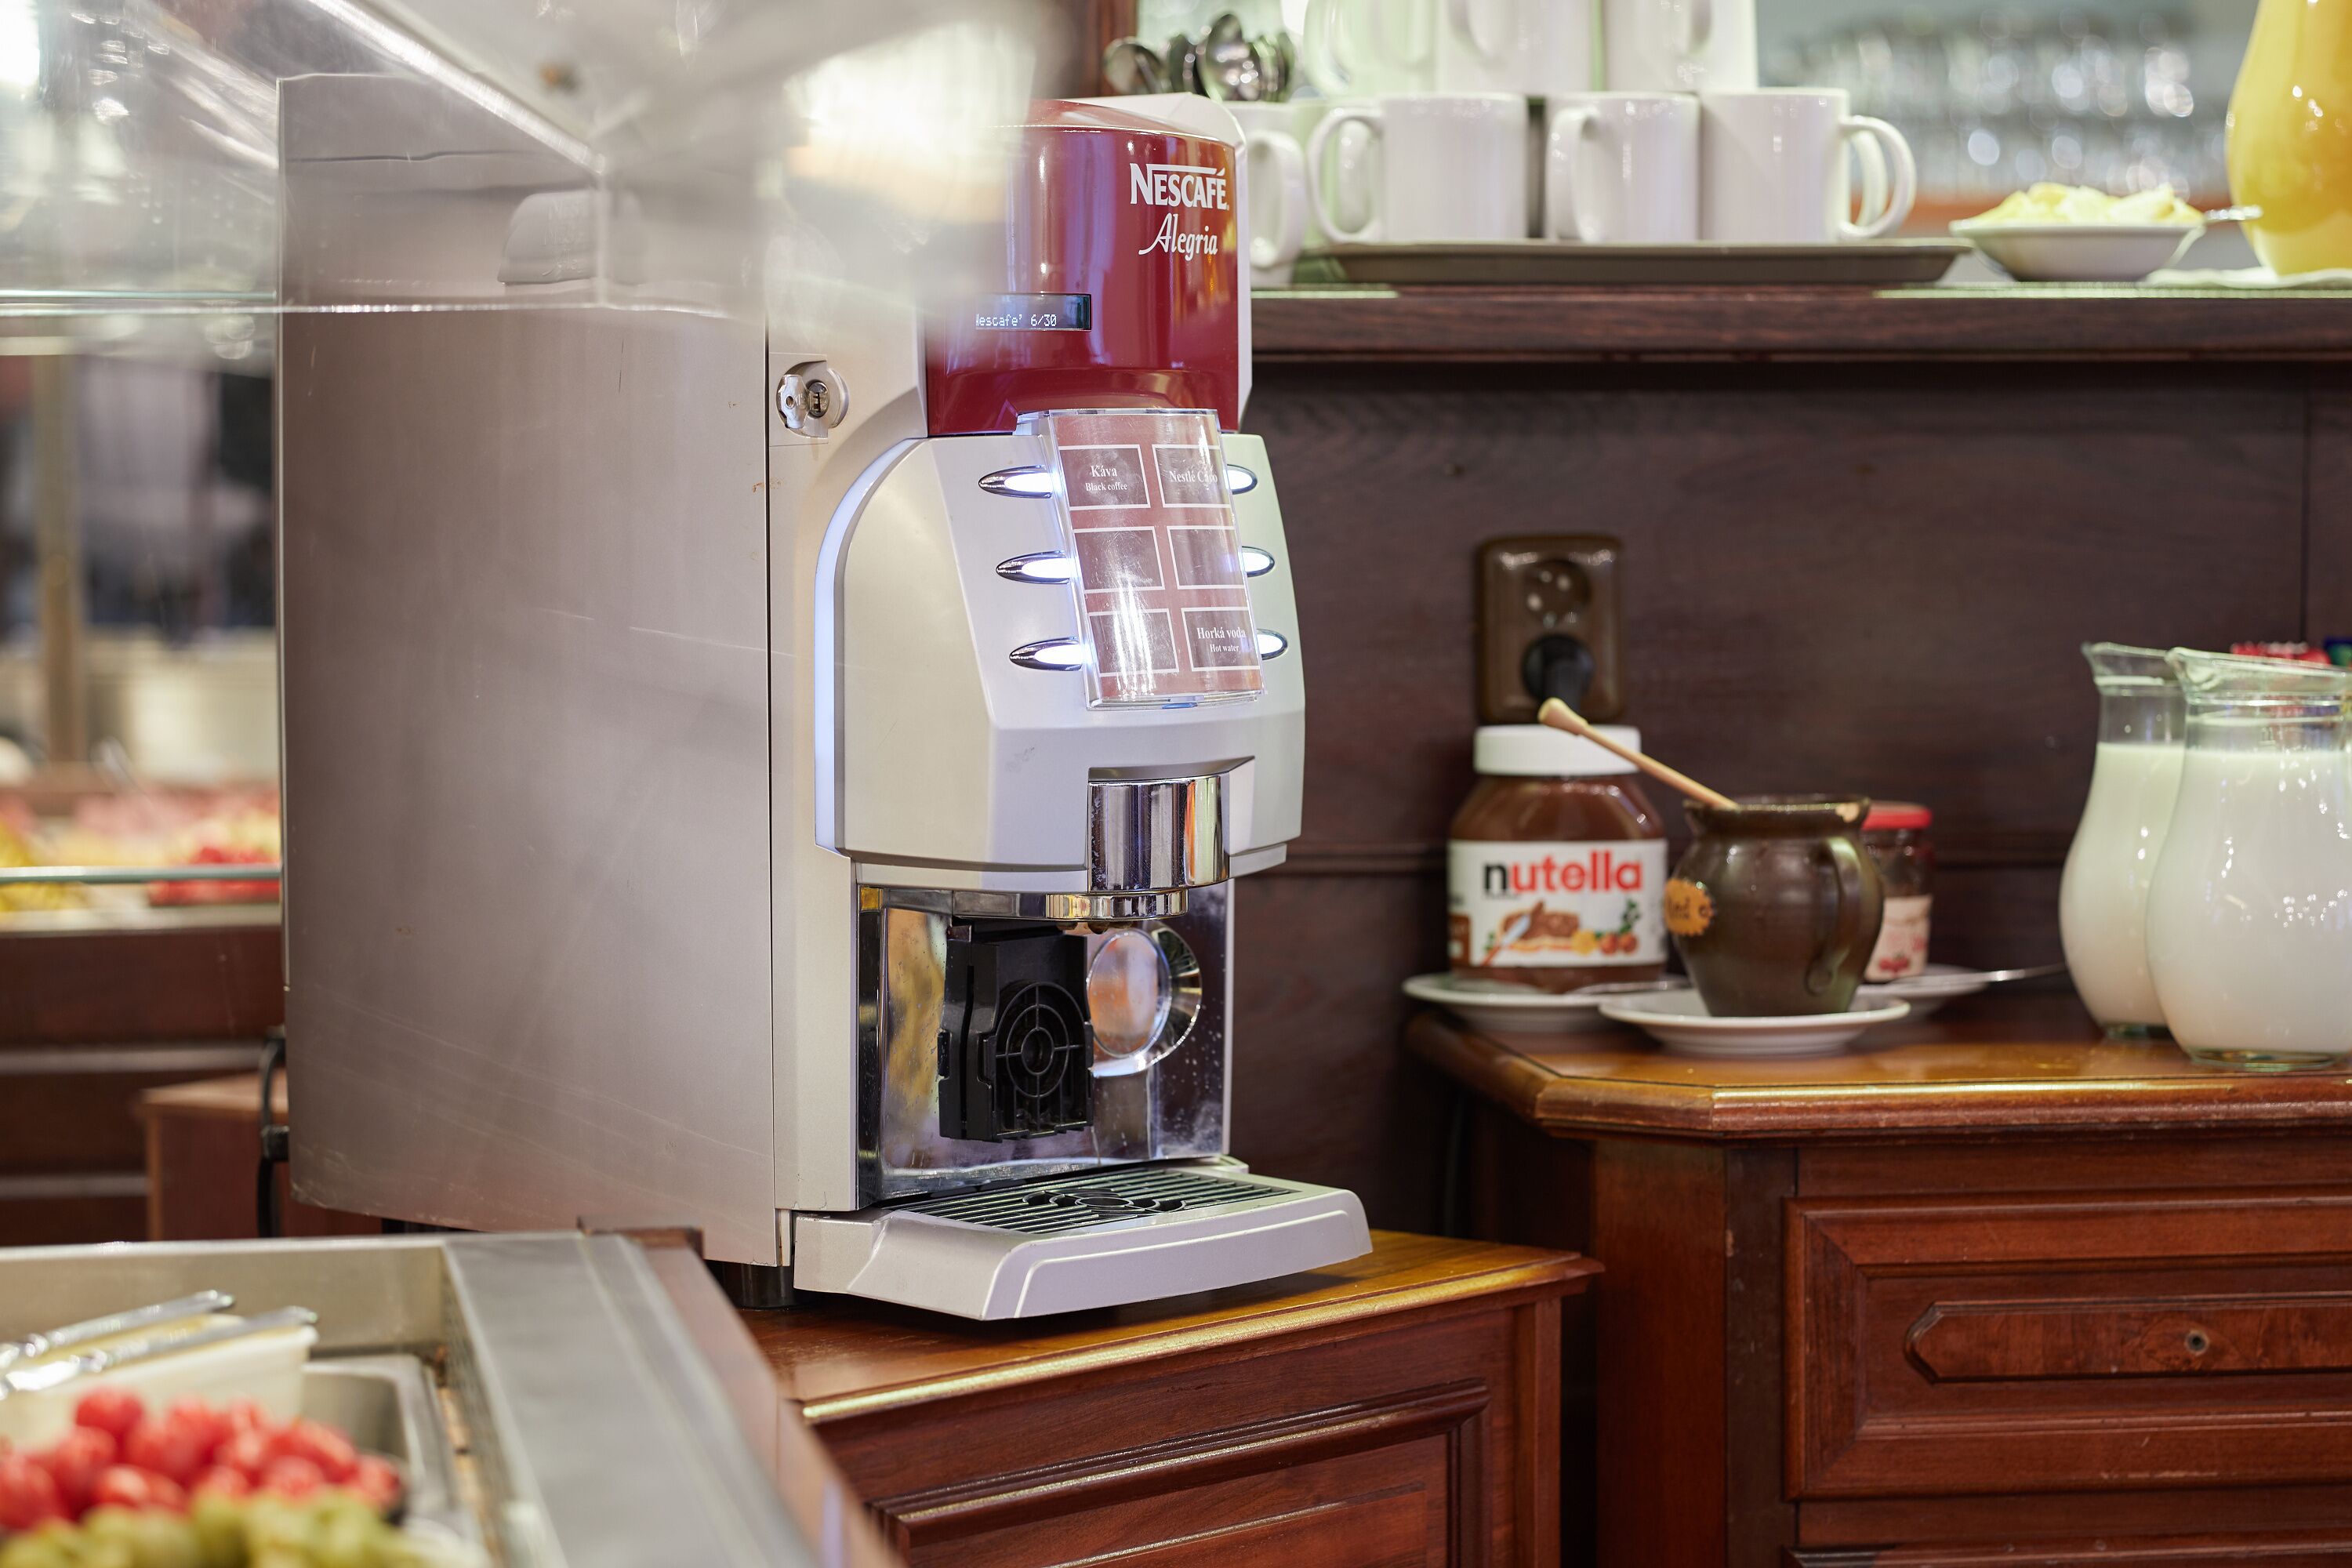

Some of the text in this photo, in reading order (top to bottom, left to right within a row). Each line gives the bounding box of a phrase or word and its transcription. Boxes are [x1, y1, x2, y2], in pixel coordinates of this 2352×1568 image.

[1129, 162, 1228, 211] NESCAFÉ
[1138, 212, 1218, 261] Alegria
[1030, 314, 1057, 327] 6/30
[1091, 464, 1118, 477] Káva
[1169, 470, 1196, 482] Nestlé
[1085, 481, 1128, 492] Black coffee
[1196, 626, 1247, 640] Horká voda
[1210, 644, 1240, 652] Hot water
[1483, 848, 1643, 892] nutella
